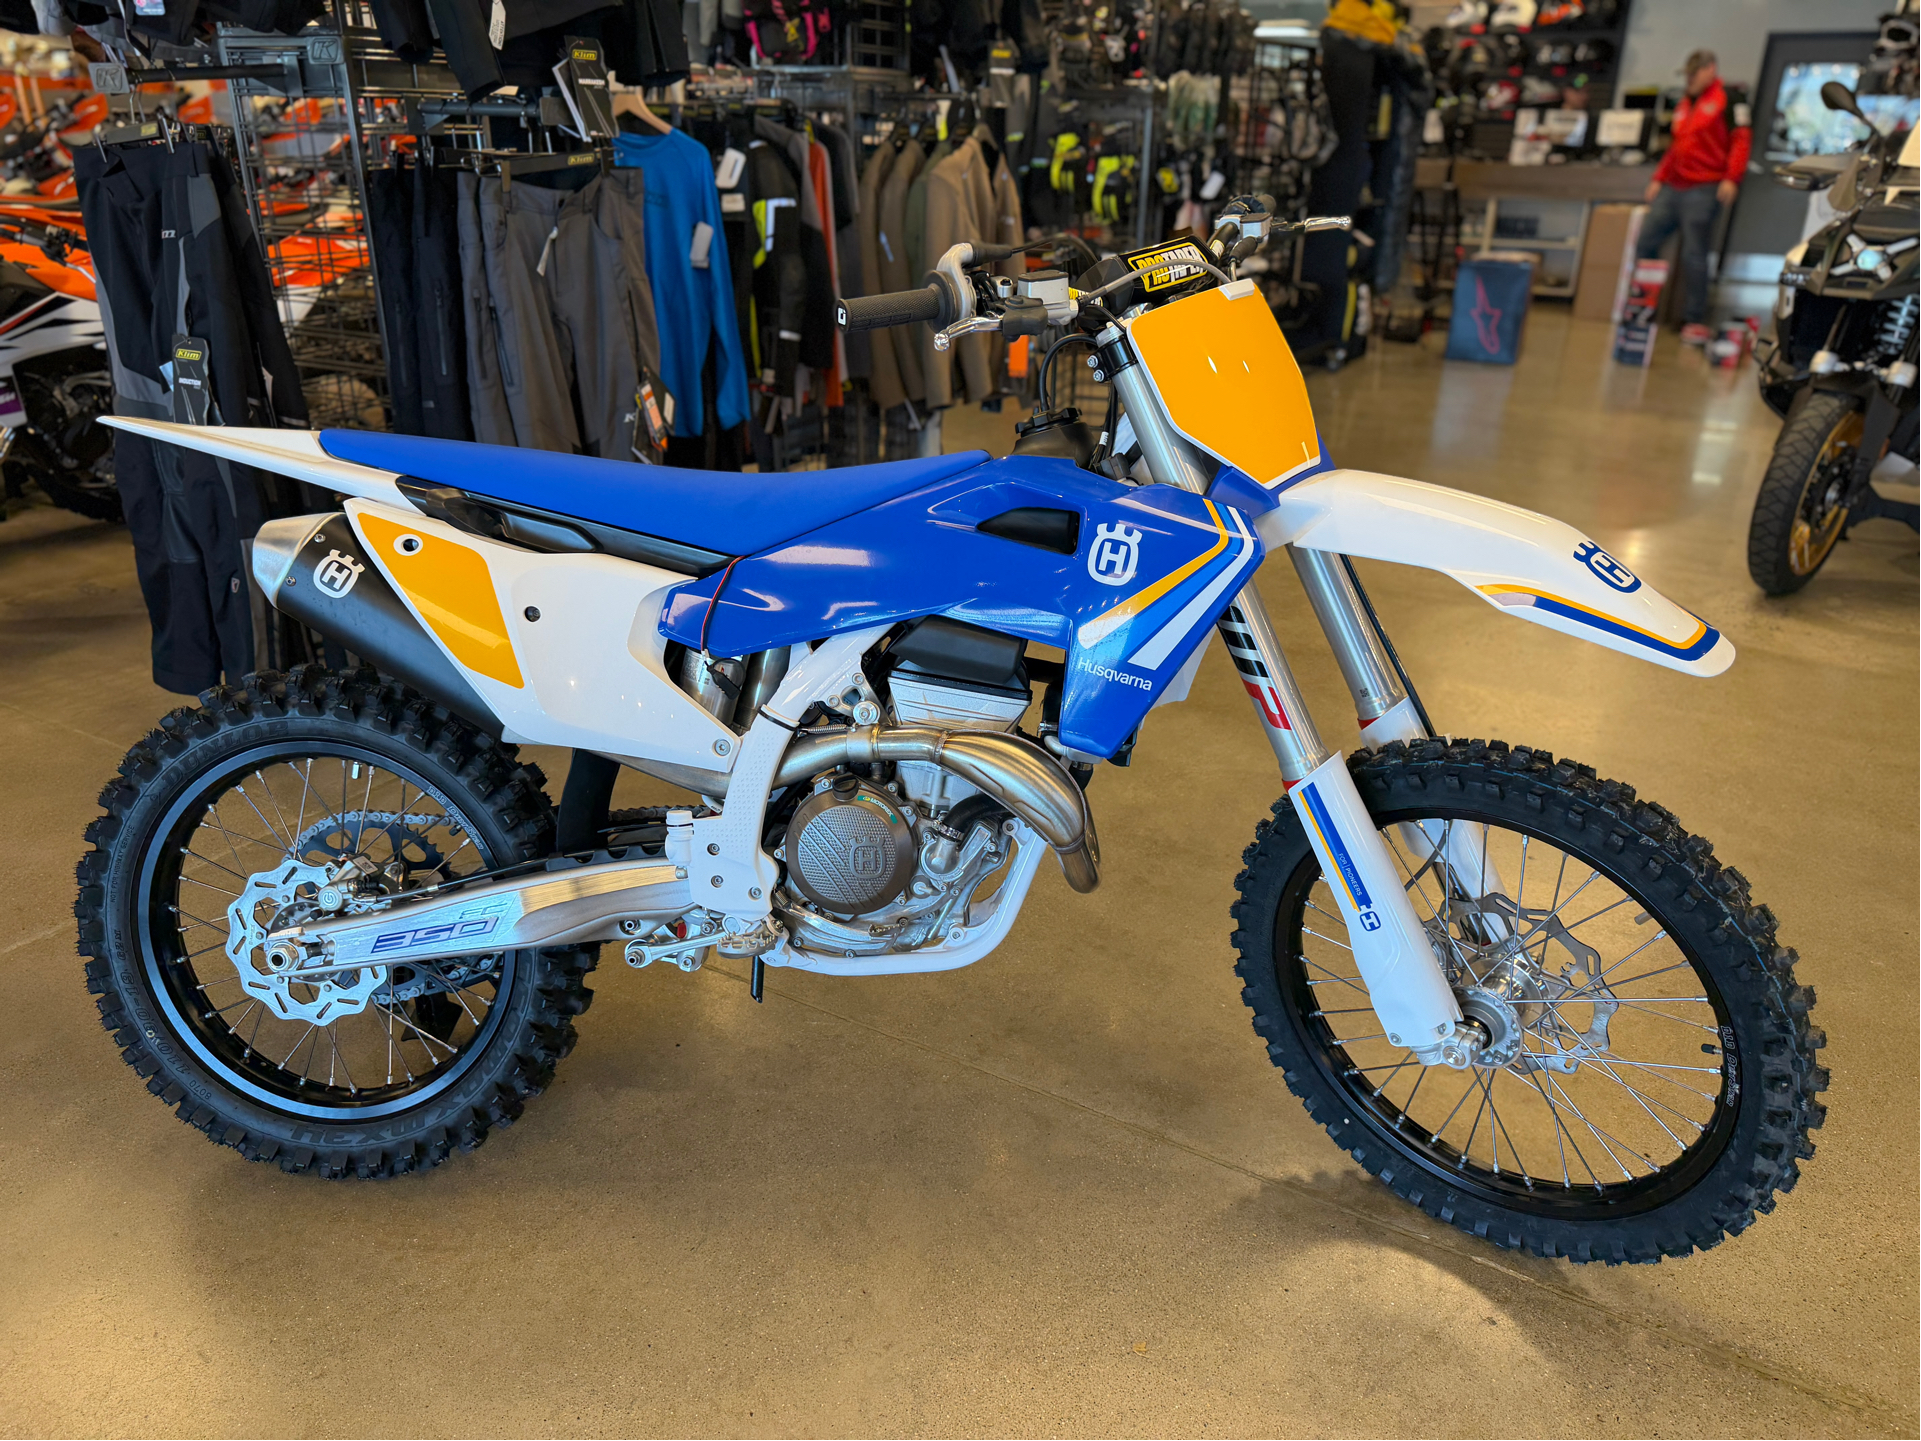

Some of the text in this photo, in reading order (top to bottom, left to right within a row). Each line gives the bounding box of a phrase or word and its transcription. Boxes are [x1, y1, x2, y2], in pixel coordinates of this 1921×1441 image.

[1077, 656, 1153, 692] Husqvarna
[160, 720, 289, 787] DUNLOP
[870, 797, 894, 818] MOTOREX
[114, 850, 124, 876] HIGHWAY
[121, 825, 135, 849] SERVICE
[1345, 867, 1363, 896] PIONEERS
[371, 916, 500, 953] 350
